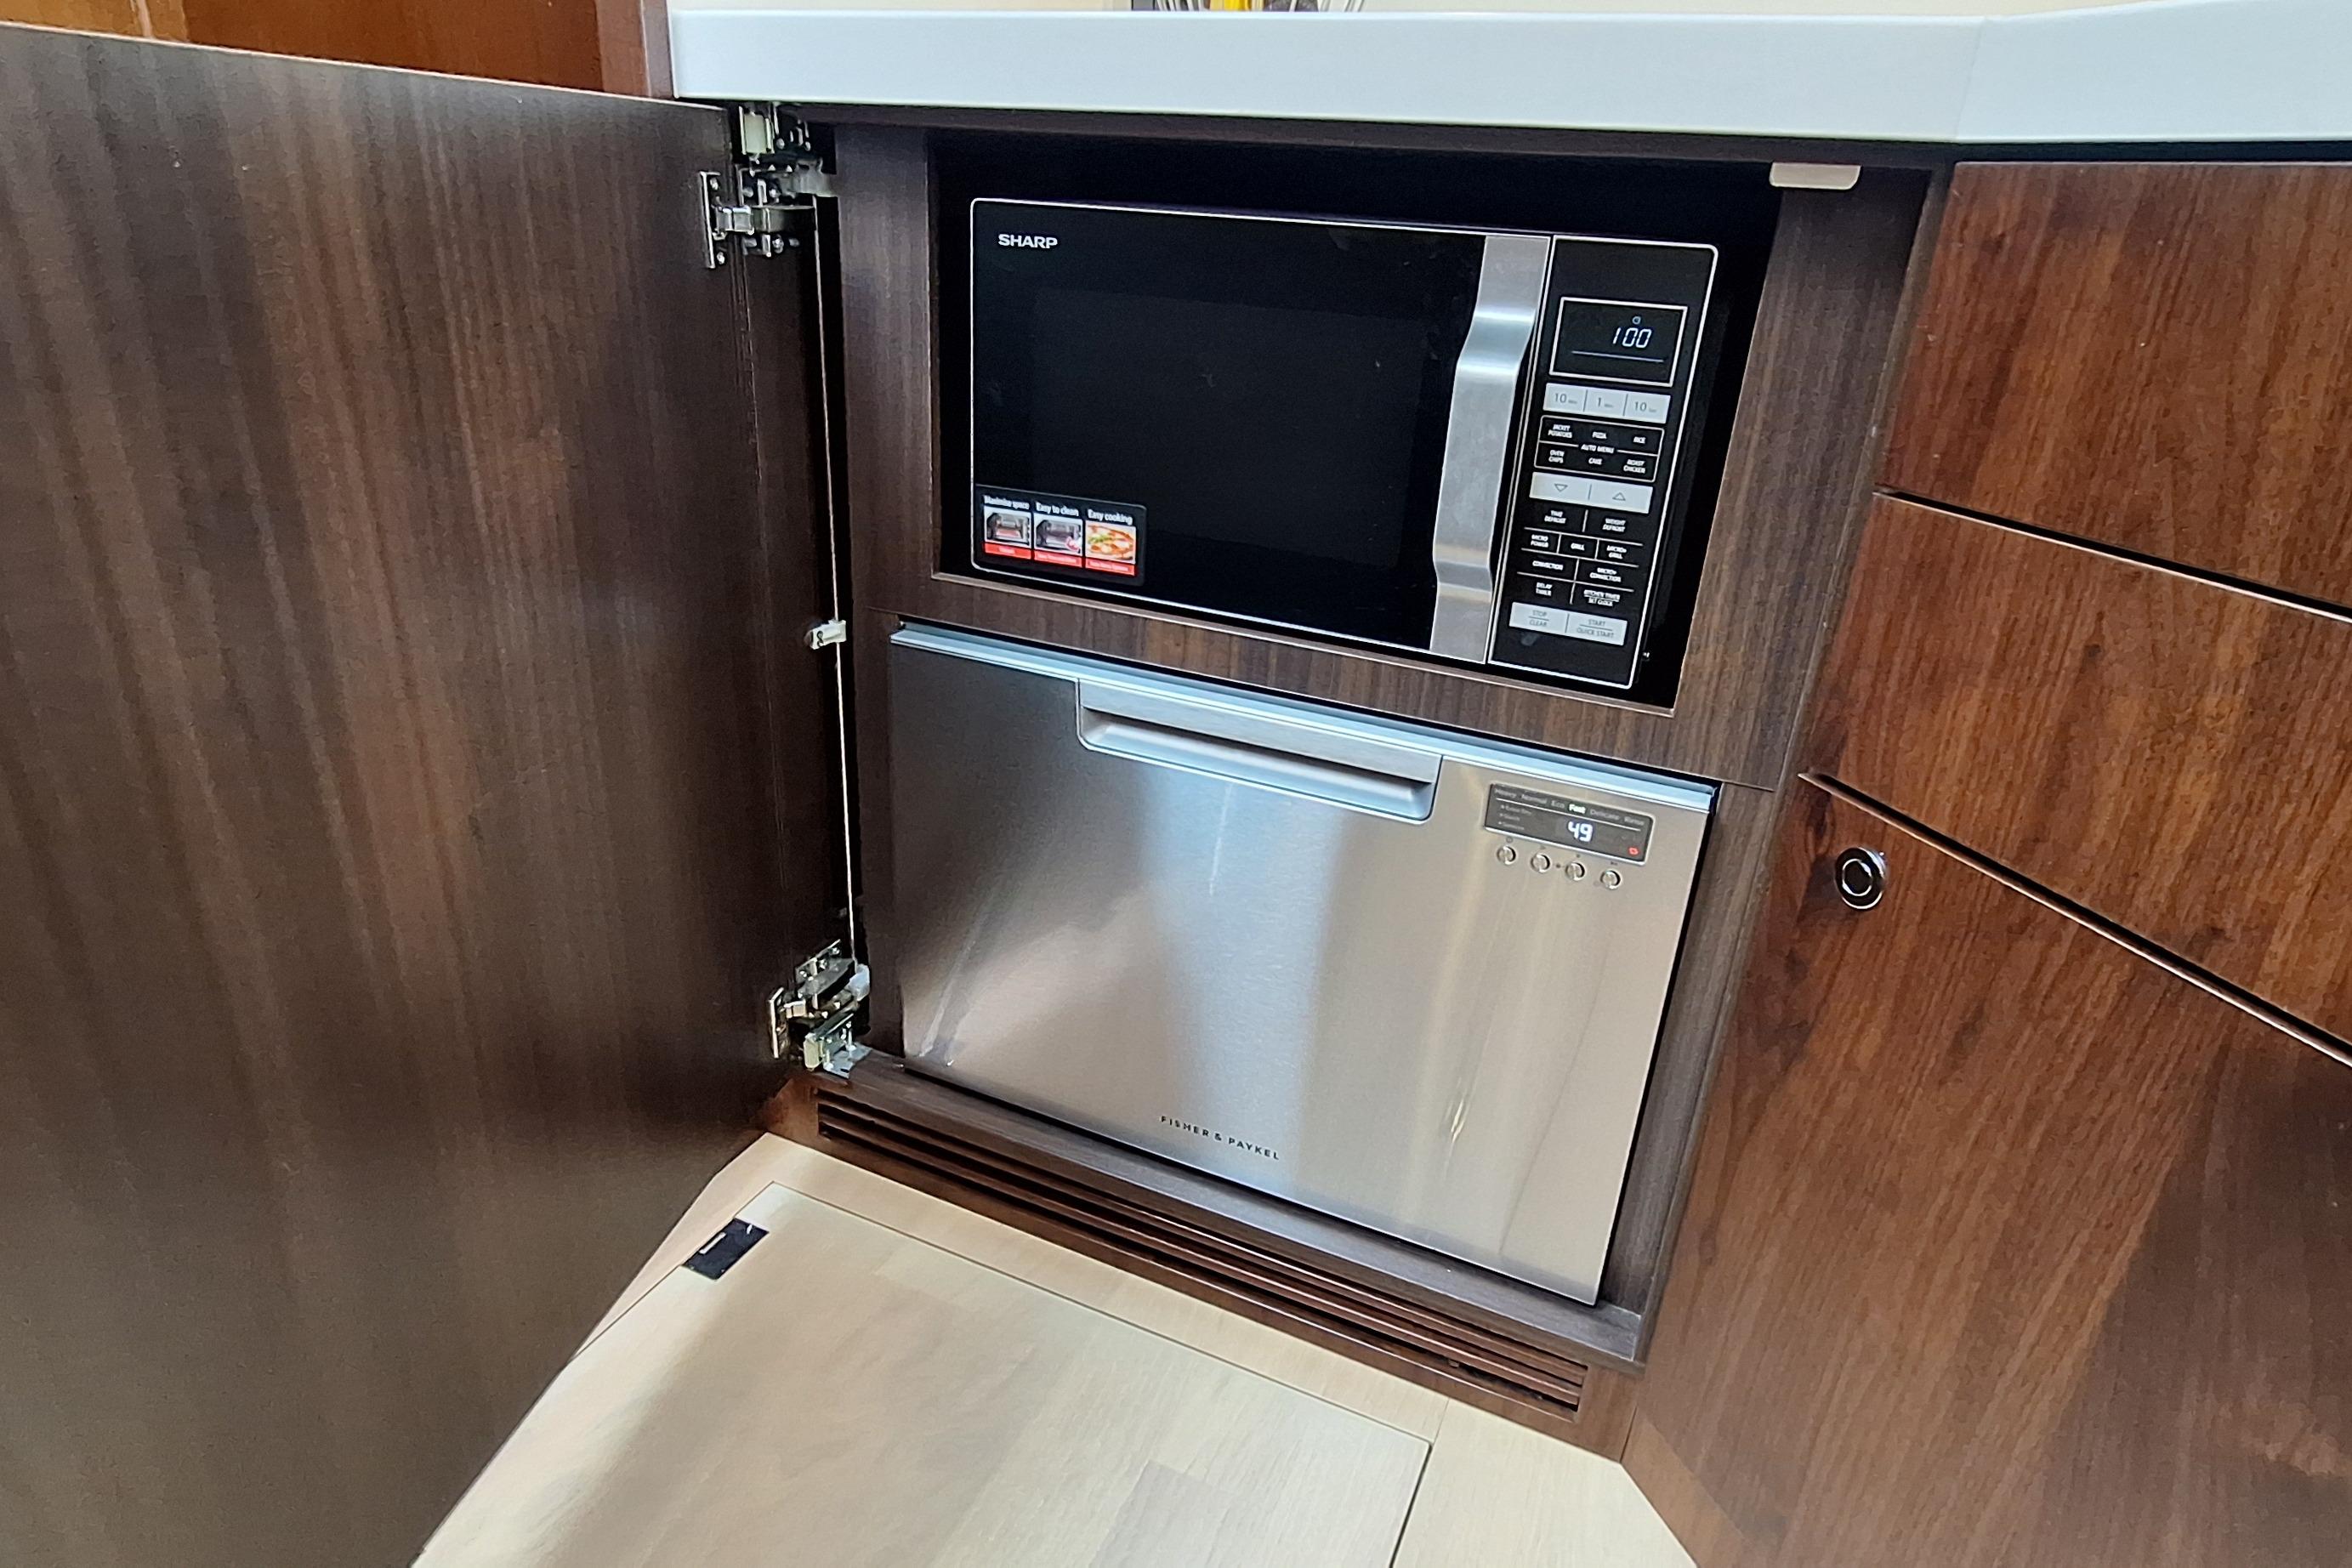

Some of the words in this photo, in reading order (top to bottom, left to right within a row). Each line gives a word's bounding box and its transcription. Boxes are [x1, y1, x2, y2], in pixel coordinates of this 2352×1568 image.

[998, 234, 1058, 248] SHARP
[1554, 393, 1567, 403] 10
[1597, 397, 1601, 406] 1
[1634, 401, 1647, 412] 10
[1597, 446, 1615, 454] MENU
[1036, 501, 1052, 514] Easy
[1052, 505, 1060, 514] to
[1060, 504, 1080, 517] clean
[1088, 509, 1104, 521] Easy
[1105, 511, 1133, 526] cooking
[1568, 804, 1586, 814] Fast
[1567, 821, 1594, 843] 49
[1160, 1116, 1209, 1137] FISHER
[1213, 1133, 1222, 1141] &
[1228, 1137, 1280, 1160] PAYKEL
